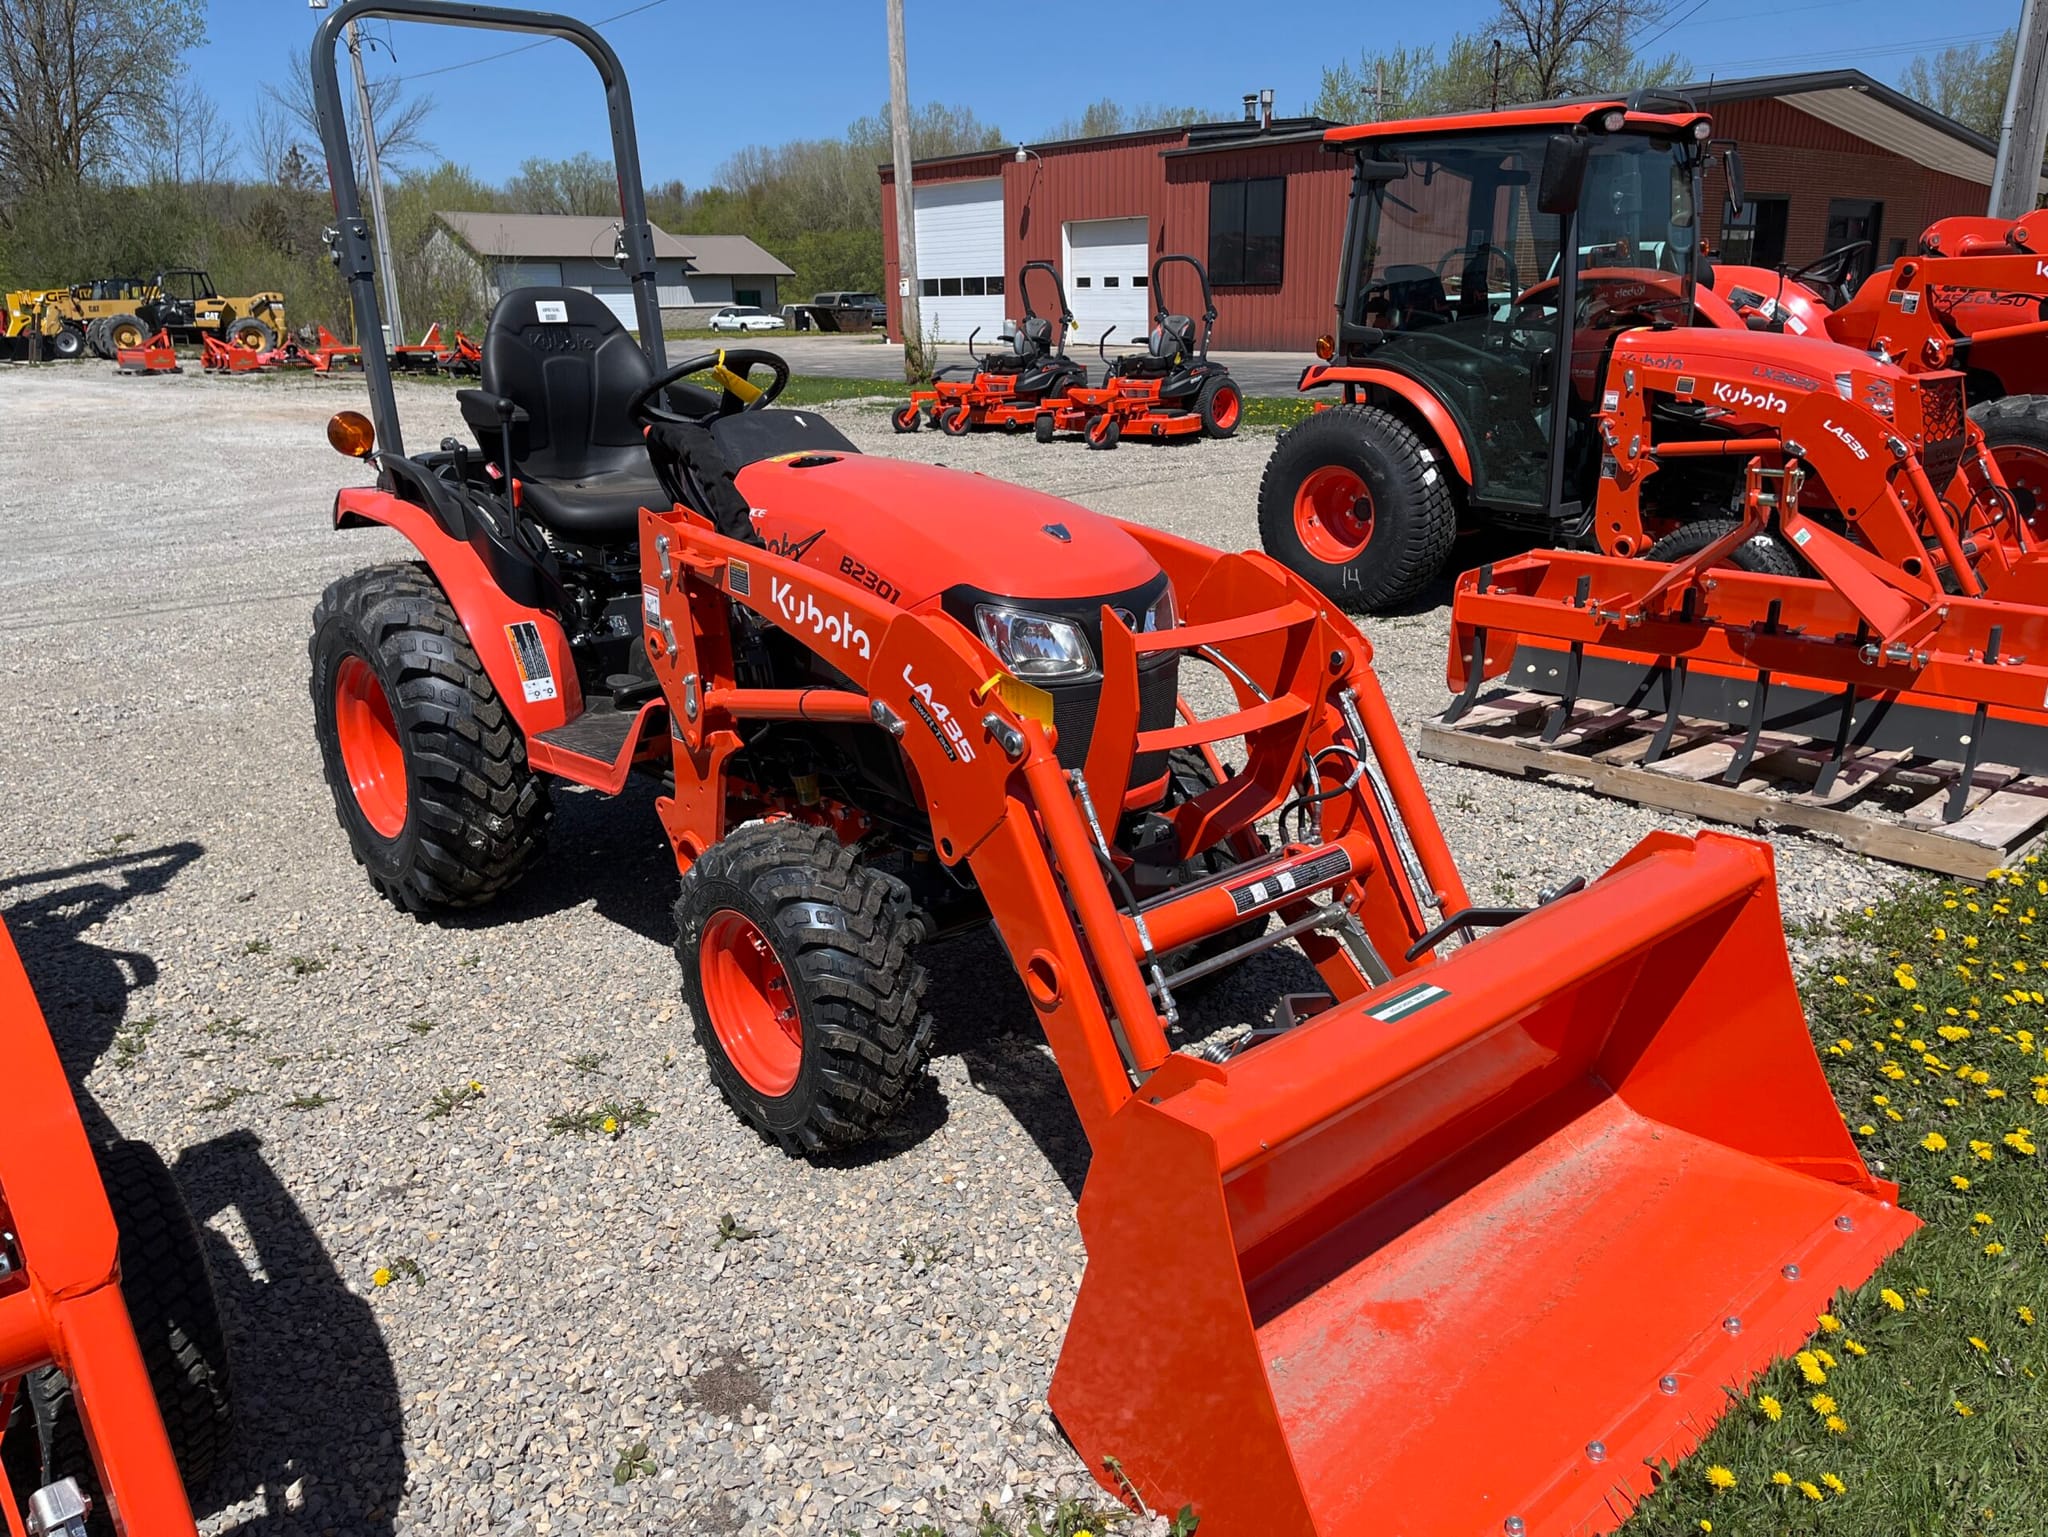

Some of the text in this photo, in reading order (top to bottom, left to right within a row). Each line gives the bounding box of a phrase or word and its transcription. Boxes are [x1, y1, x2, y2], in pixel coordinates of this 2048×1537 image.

[204, 311, 219, 321] CAT
[528, 332, 594, 351] Kubota
[1712, 381, 1787, 414] Kubota
[1823, 419, 1870, 460] LA535
[839, 555, 901, 605] B2301
[1342, 566, 1362, 591] 14
[771, 576, 870, 660] Kubota
[902, 663, 976, 763] LA435
[911, 698, 955, 759] Swift-Tach
